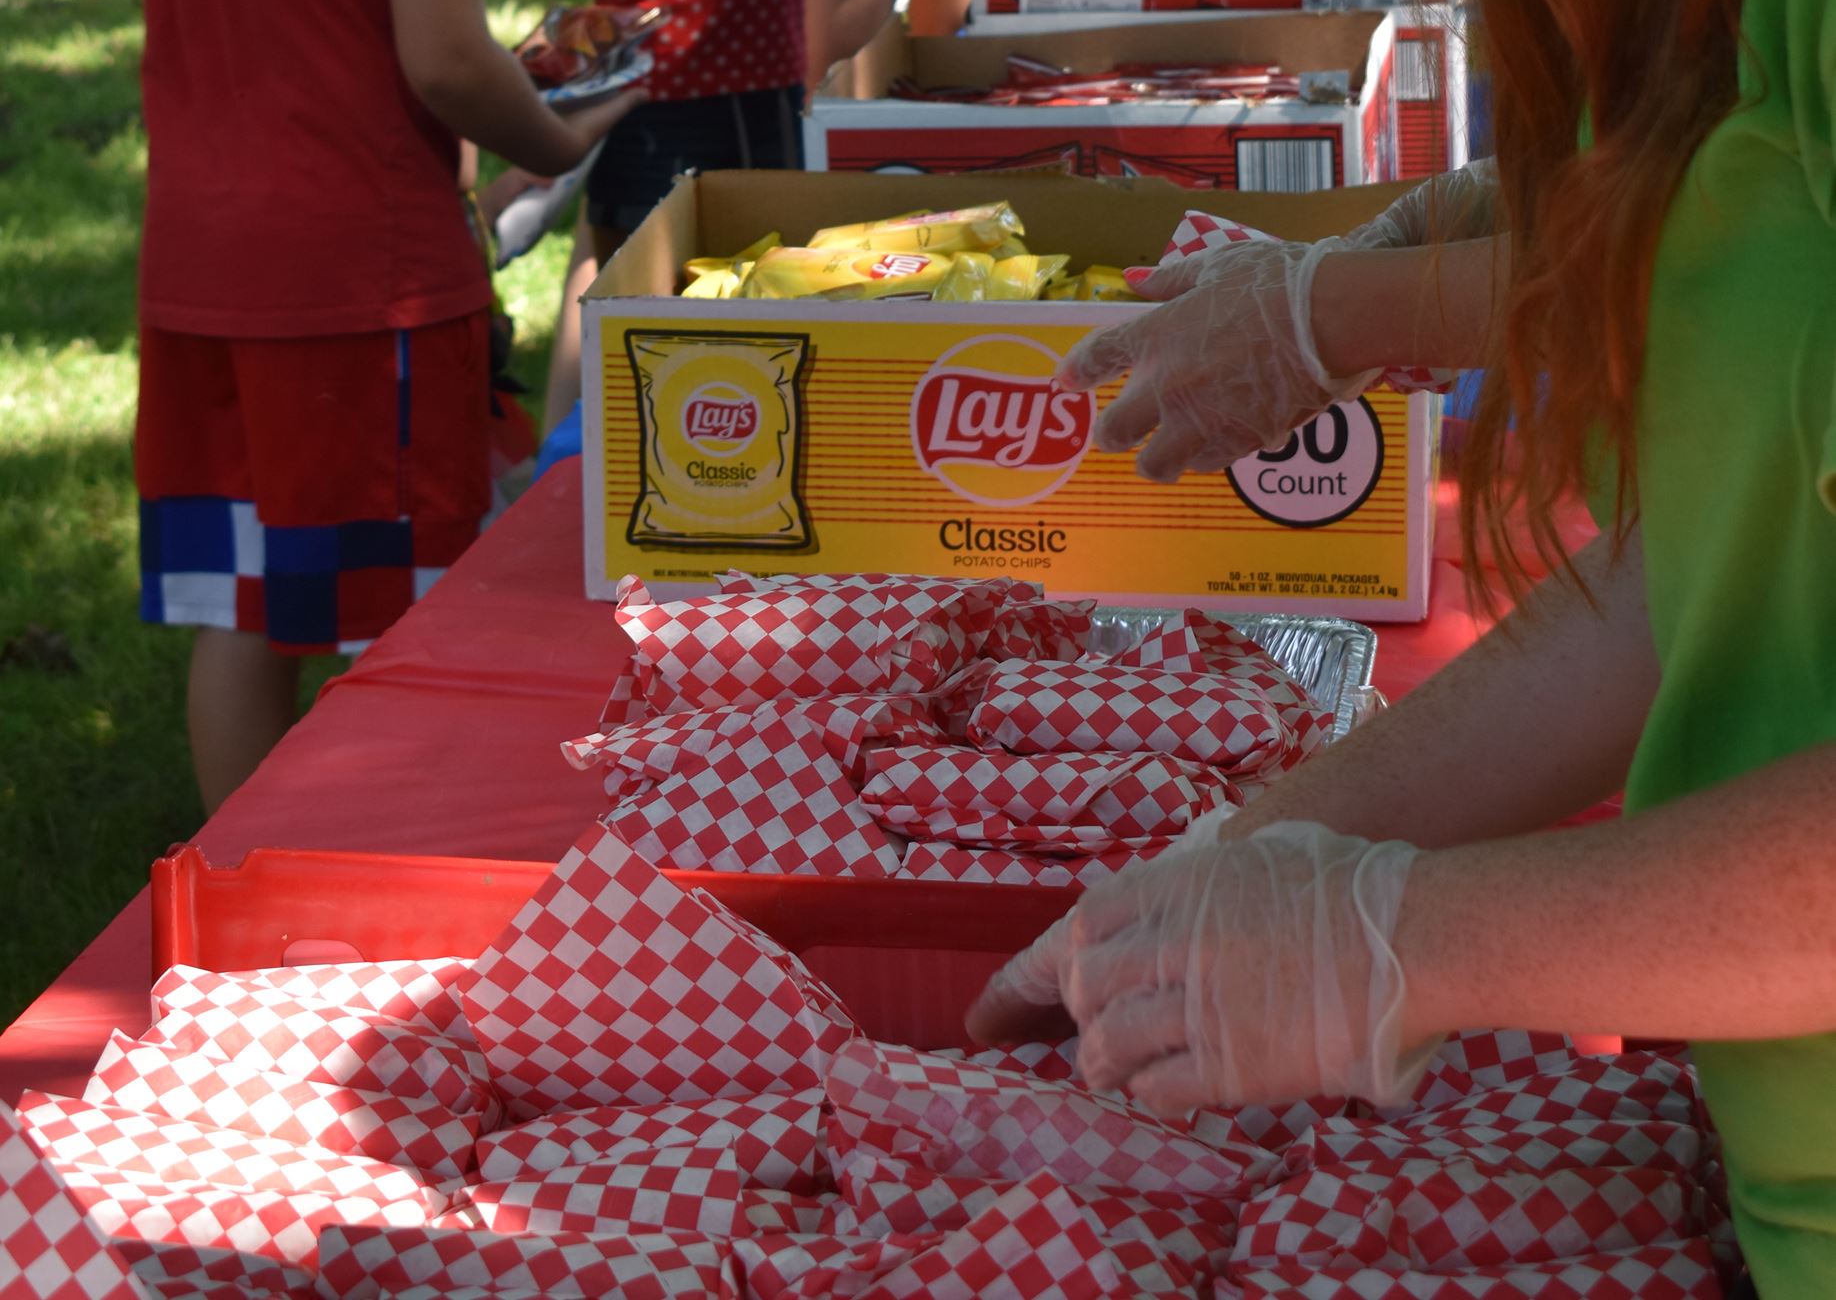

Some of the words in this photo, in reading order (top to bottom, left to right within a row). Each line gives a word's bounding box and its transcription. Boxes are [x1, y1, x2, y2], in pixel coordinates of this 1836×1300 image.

[690, 401, 753, 438] Lay's
[927, 378, 1081, 467] Lay's
[686, 460, 757, 480] Classic
[1257, 468, 1347, 495] Count
[939, 517, 1067, 553] Classic
[953, 555, 1007, 568] POTATO
[1010, 557, 1051, 569] CHIPS
[1207, 581, 1236, 592] TOTAL
[1239, 582, 1256, 592] NET
[1279, 583, 1290, 593] 50
[1371, 586, 1384, 595] 1.4
[1387, 586, 1398, 597] kg
[1229, 572, 1240, 581] 50
[1275, 572, 1328, 583] INDIVIDUAL
[1331, 573, 1380, 584] PACKAGES
